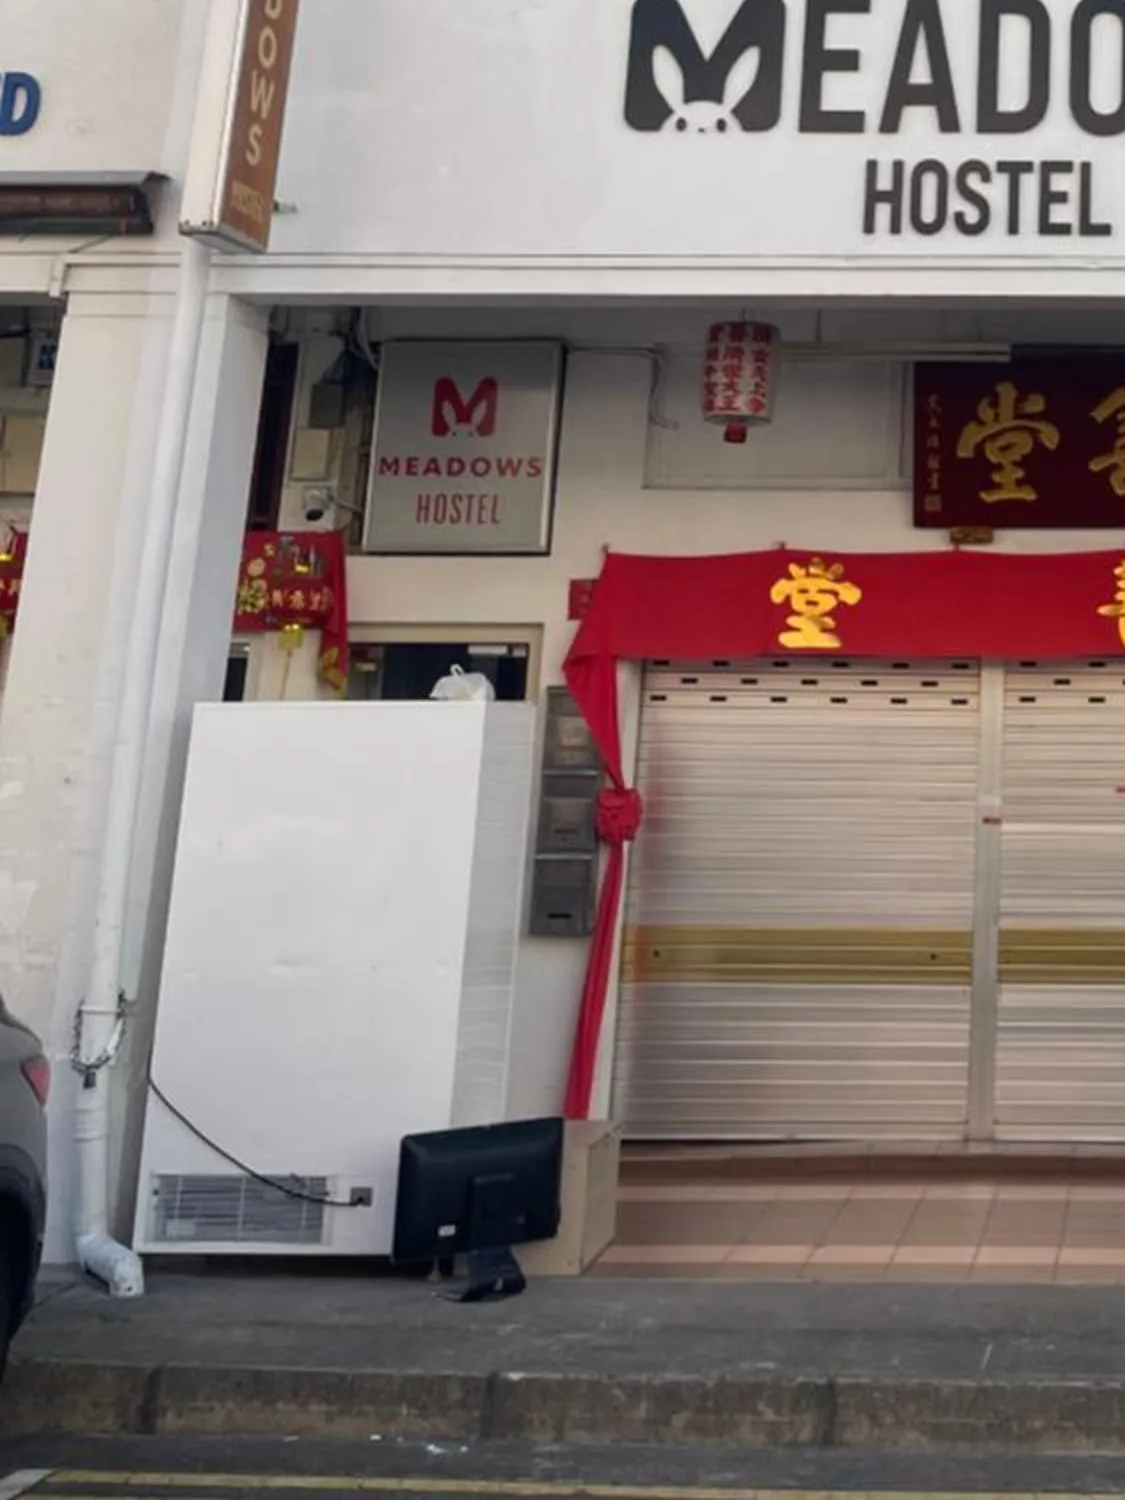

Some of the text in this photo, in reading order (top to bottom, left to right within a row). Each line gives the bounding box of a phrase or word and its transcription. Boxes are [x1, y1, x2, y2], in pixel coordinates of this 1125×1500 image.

[0, 71, 42, 136] D
[863, 158, 1112, 236] HOSTEL
[378, 456, 543, 478] MEADOWS
[416, 493, 503, 526] HOSTEL
